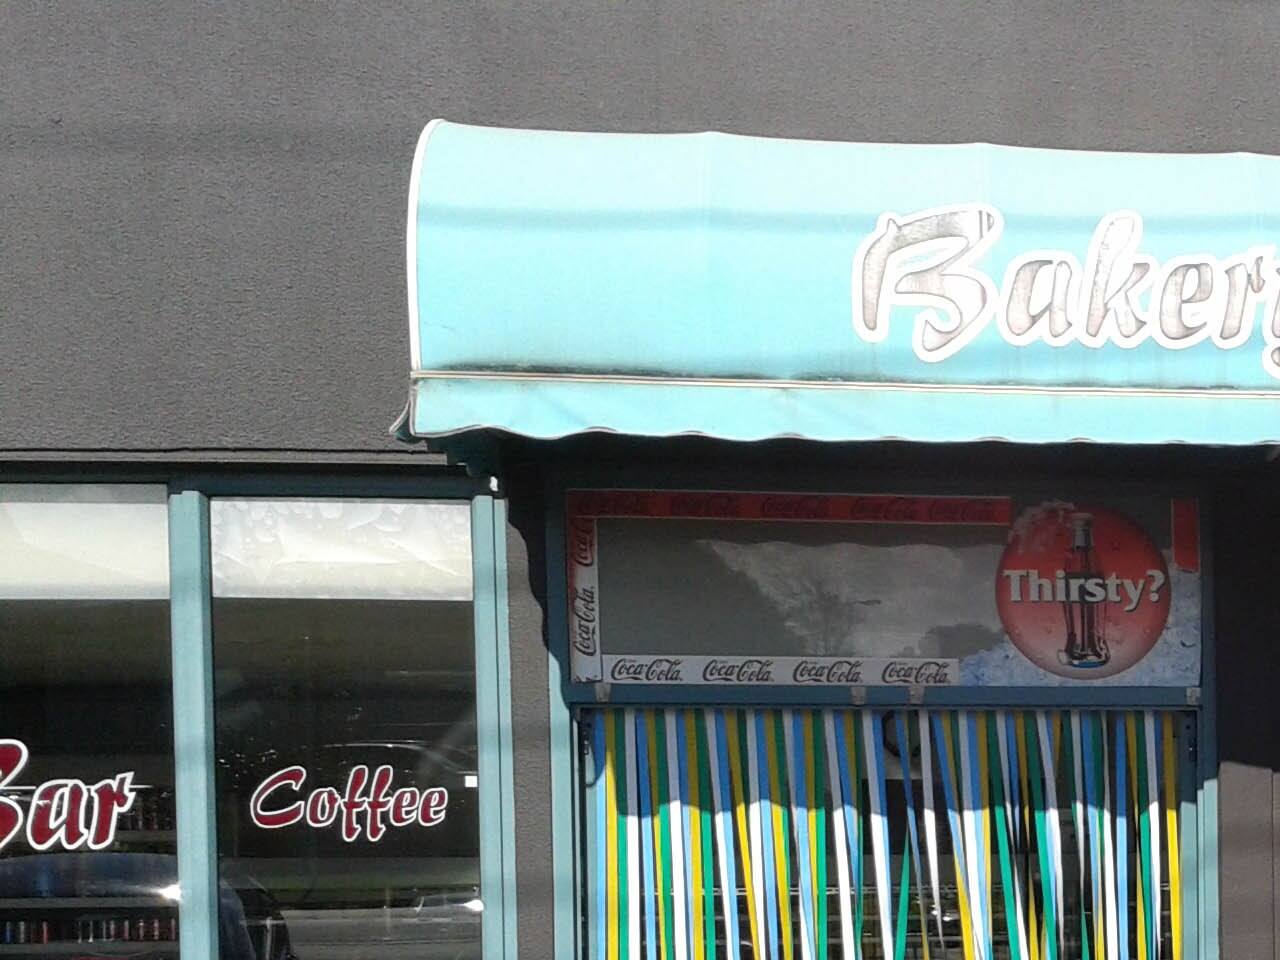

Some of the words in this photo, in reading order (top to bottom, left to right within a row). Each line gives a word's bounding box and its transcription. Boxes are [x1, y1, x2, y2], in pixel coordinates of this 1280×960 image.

[1002, 569, 1166, 612] Thirsty?
[0, 738, 136, 851] ar
[250, 764, 448, 843] Coffee
